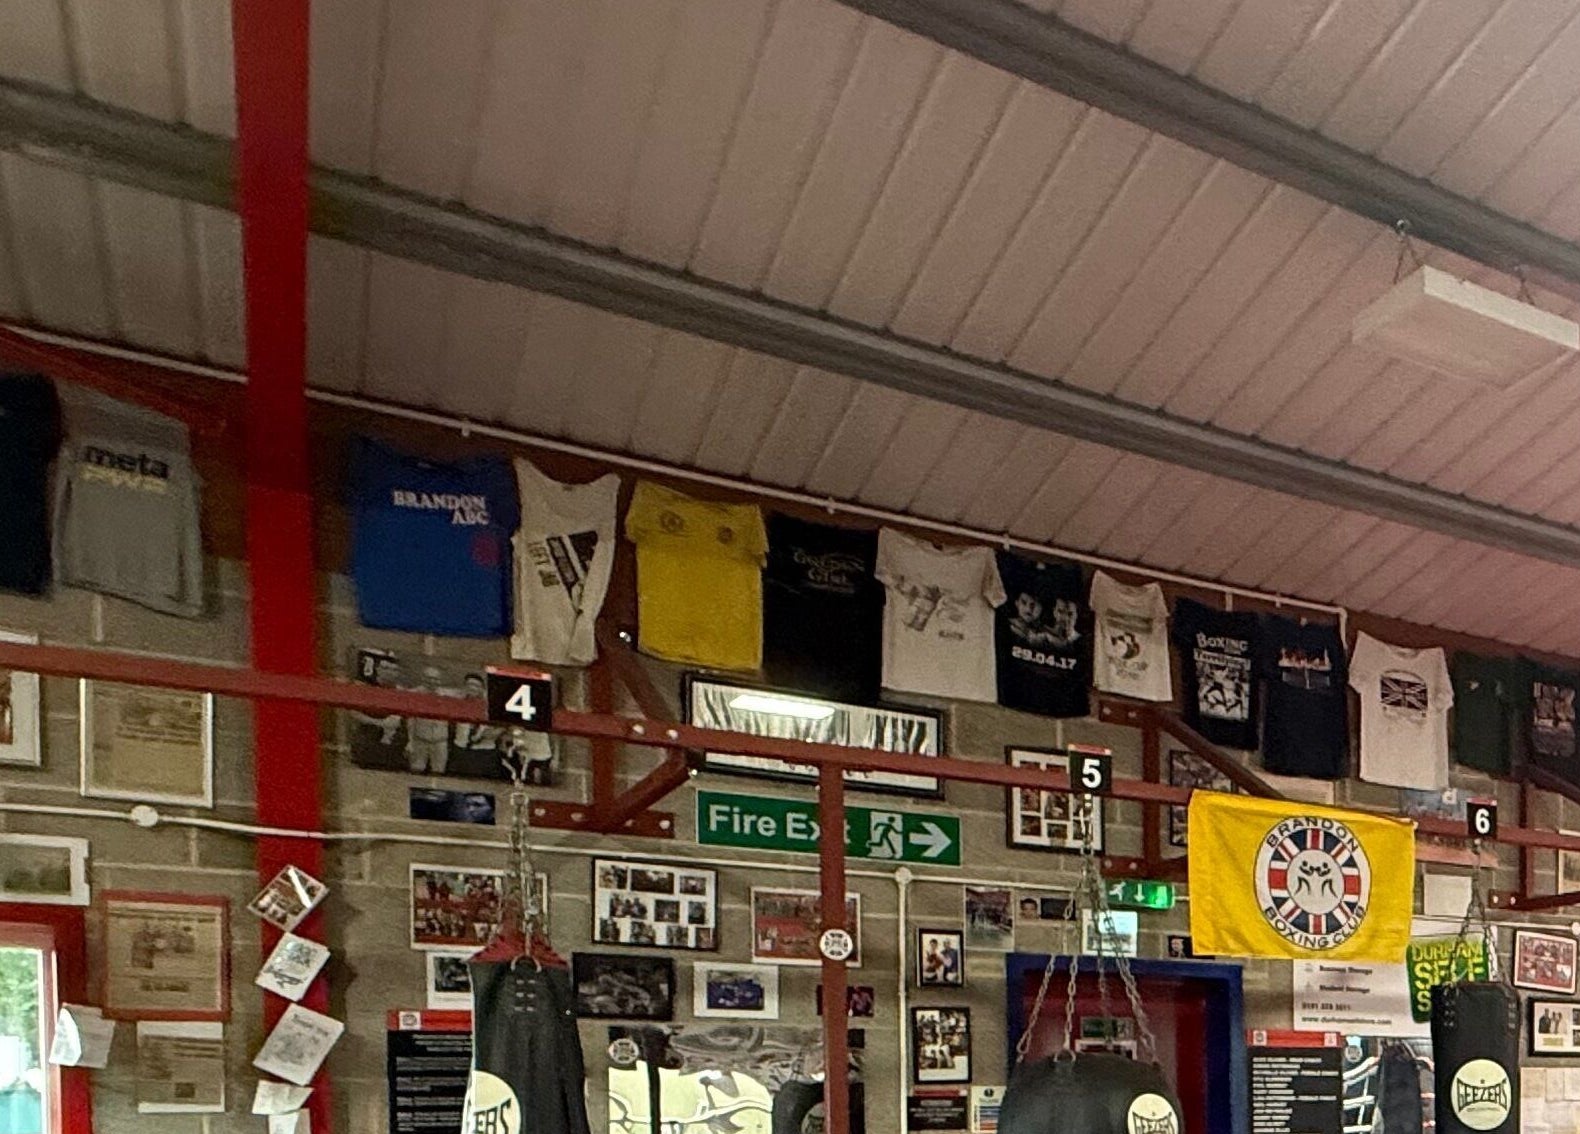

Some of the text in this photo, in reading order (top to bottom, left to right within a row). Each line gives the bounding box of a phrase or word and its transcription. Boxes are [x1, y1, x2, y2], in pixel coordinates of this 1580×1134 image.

[393, 490, 487, 512] BRANDON
[452, 509, 489, 525] ABC
[1012, 645, 1077, 671] 29.04.17
[505, 684, 537, 721] 4
[1081, 758, 1102, 788] 5
[708, 804, 851, 844] Fire Ex
[1266, 816, 1359, 852] BRANDON
[1475, 808, 1490, 834] 6
[1265, 905, 1365, 948] BOXING CLUB
[1412, 942, 1484, 963] DURHAM
[1457, 1078, 1507, 1113] GEEZERS
